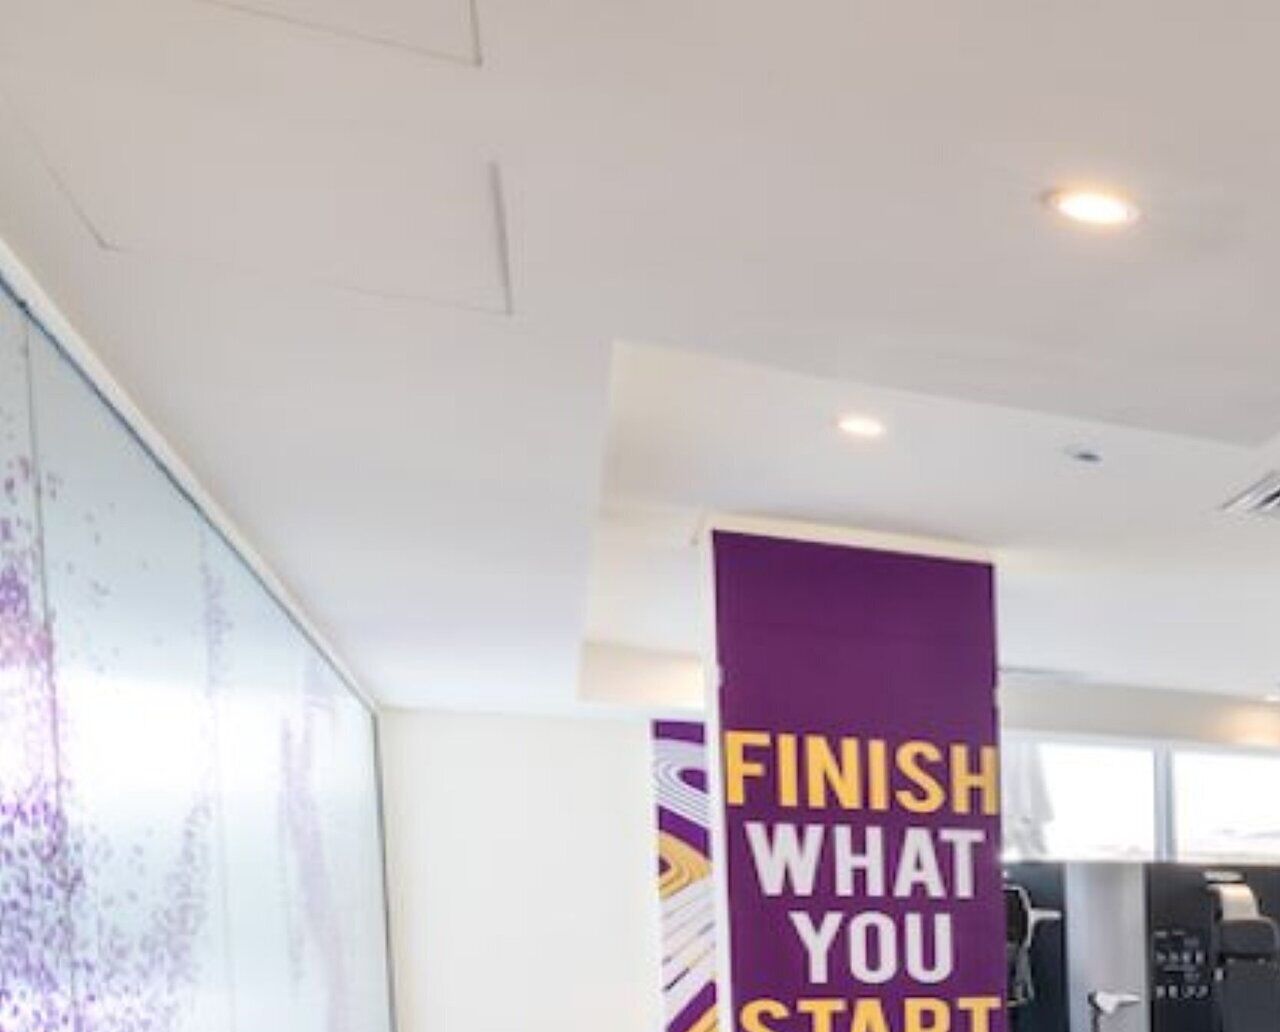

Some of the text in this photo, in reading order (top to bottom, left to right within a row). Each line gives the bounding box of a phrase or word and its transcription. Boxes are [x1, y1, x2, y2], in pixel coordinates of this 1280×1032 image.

[724, 730, 1000, 815] FINISH
[744, 820, 986, 899] WHAT
[788, 910, 954, 985] YOU
